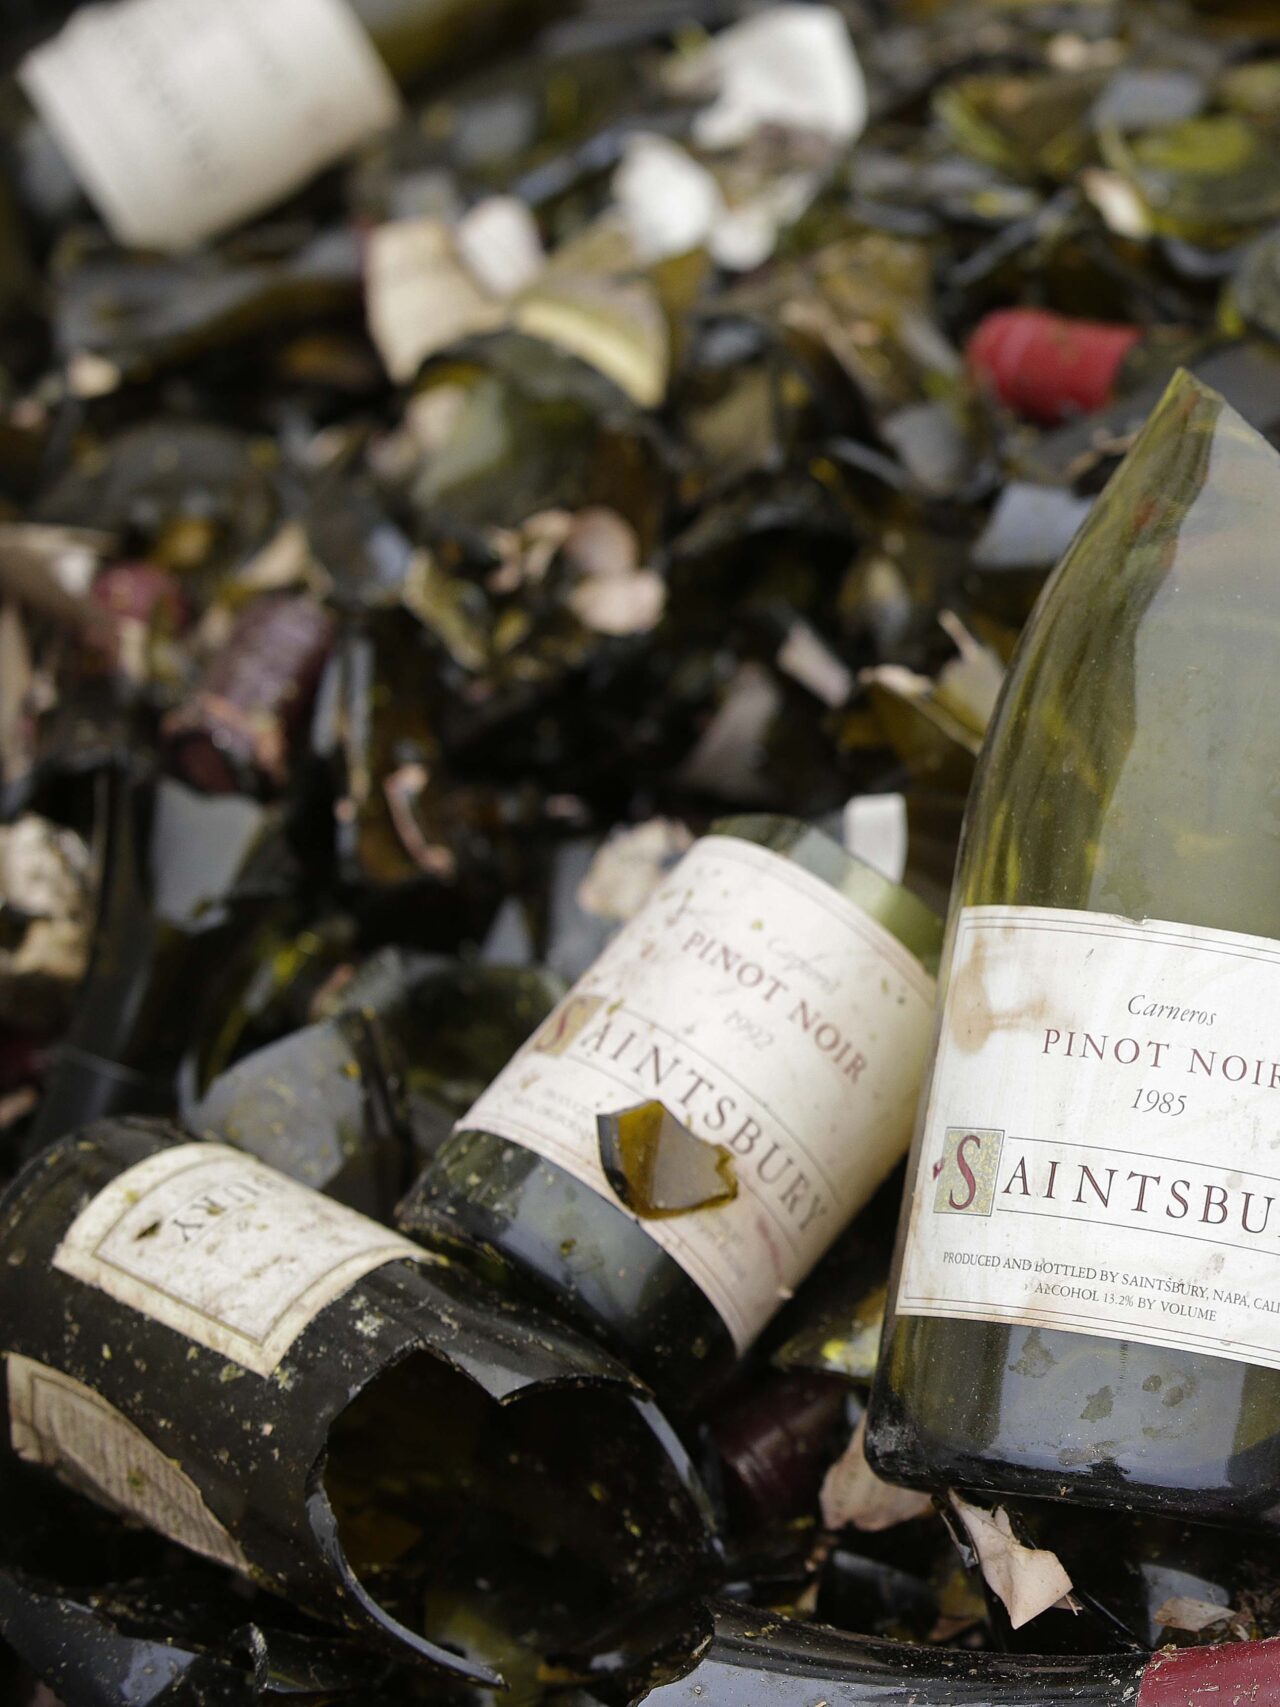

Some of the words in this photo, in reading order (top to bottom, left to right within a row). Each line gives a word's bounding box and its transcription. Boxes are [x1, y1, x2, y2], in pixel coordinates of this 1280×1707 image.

[680, 928, 789, 1004] PINOT
[786, 998, 872, 1087] NOIR
[1127, 994, 1218, 1027] Carneros
[723, 1008, 776, 1053] 1992
[1041, 1027, 1170, 1070] PINOT
[535, 995, 828, 1234] SAINTSBURY
[1129, 1086, 1188, 1117] 1985
[942, 1251, 1001, 1268] PRODUCED
[1002, 1257, 1033, 1272] AND
[1035, 1260, 1097, 1281] BOTTLED
[1099, 1269, 1121, 1284] BY
[1121, 1273, 1210, 1300] SAINTSBURY,
[1213, 1288, 1251, 1309] NAPA,
[1034, 1282, 1100, 1302] ALCOHOL
[1103, 1291, 1135, 1308] 13.2%
[1137, 1296, 1158, 1310] BY
[1160, 1300, 1218, 1322] VOLUME
